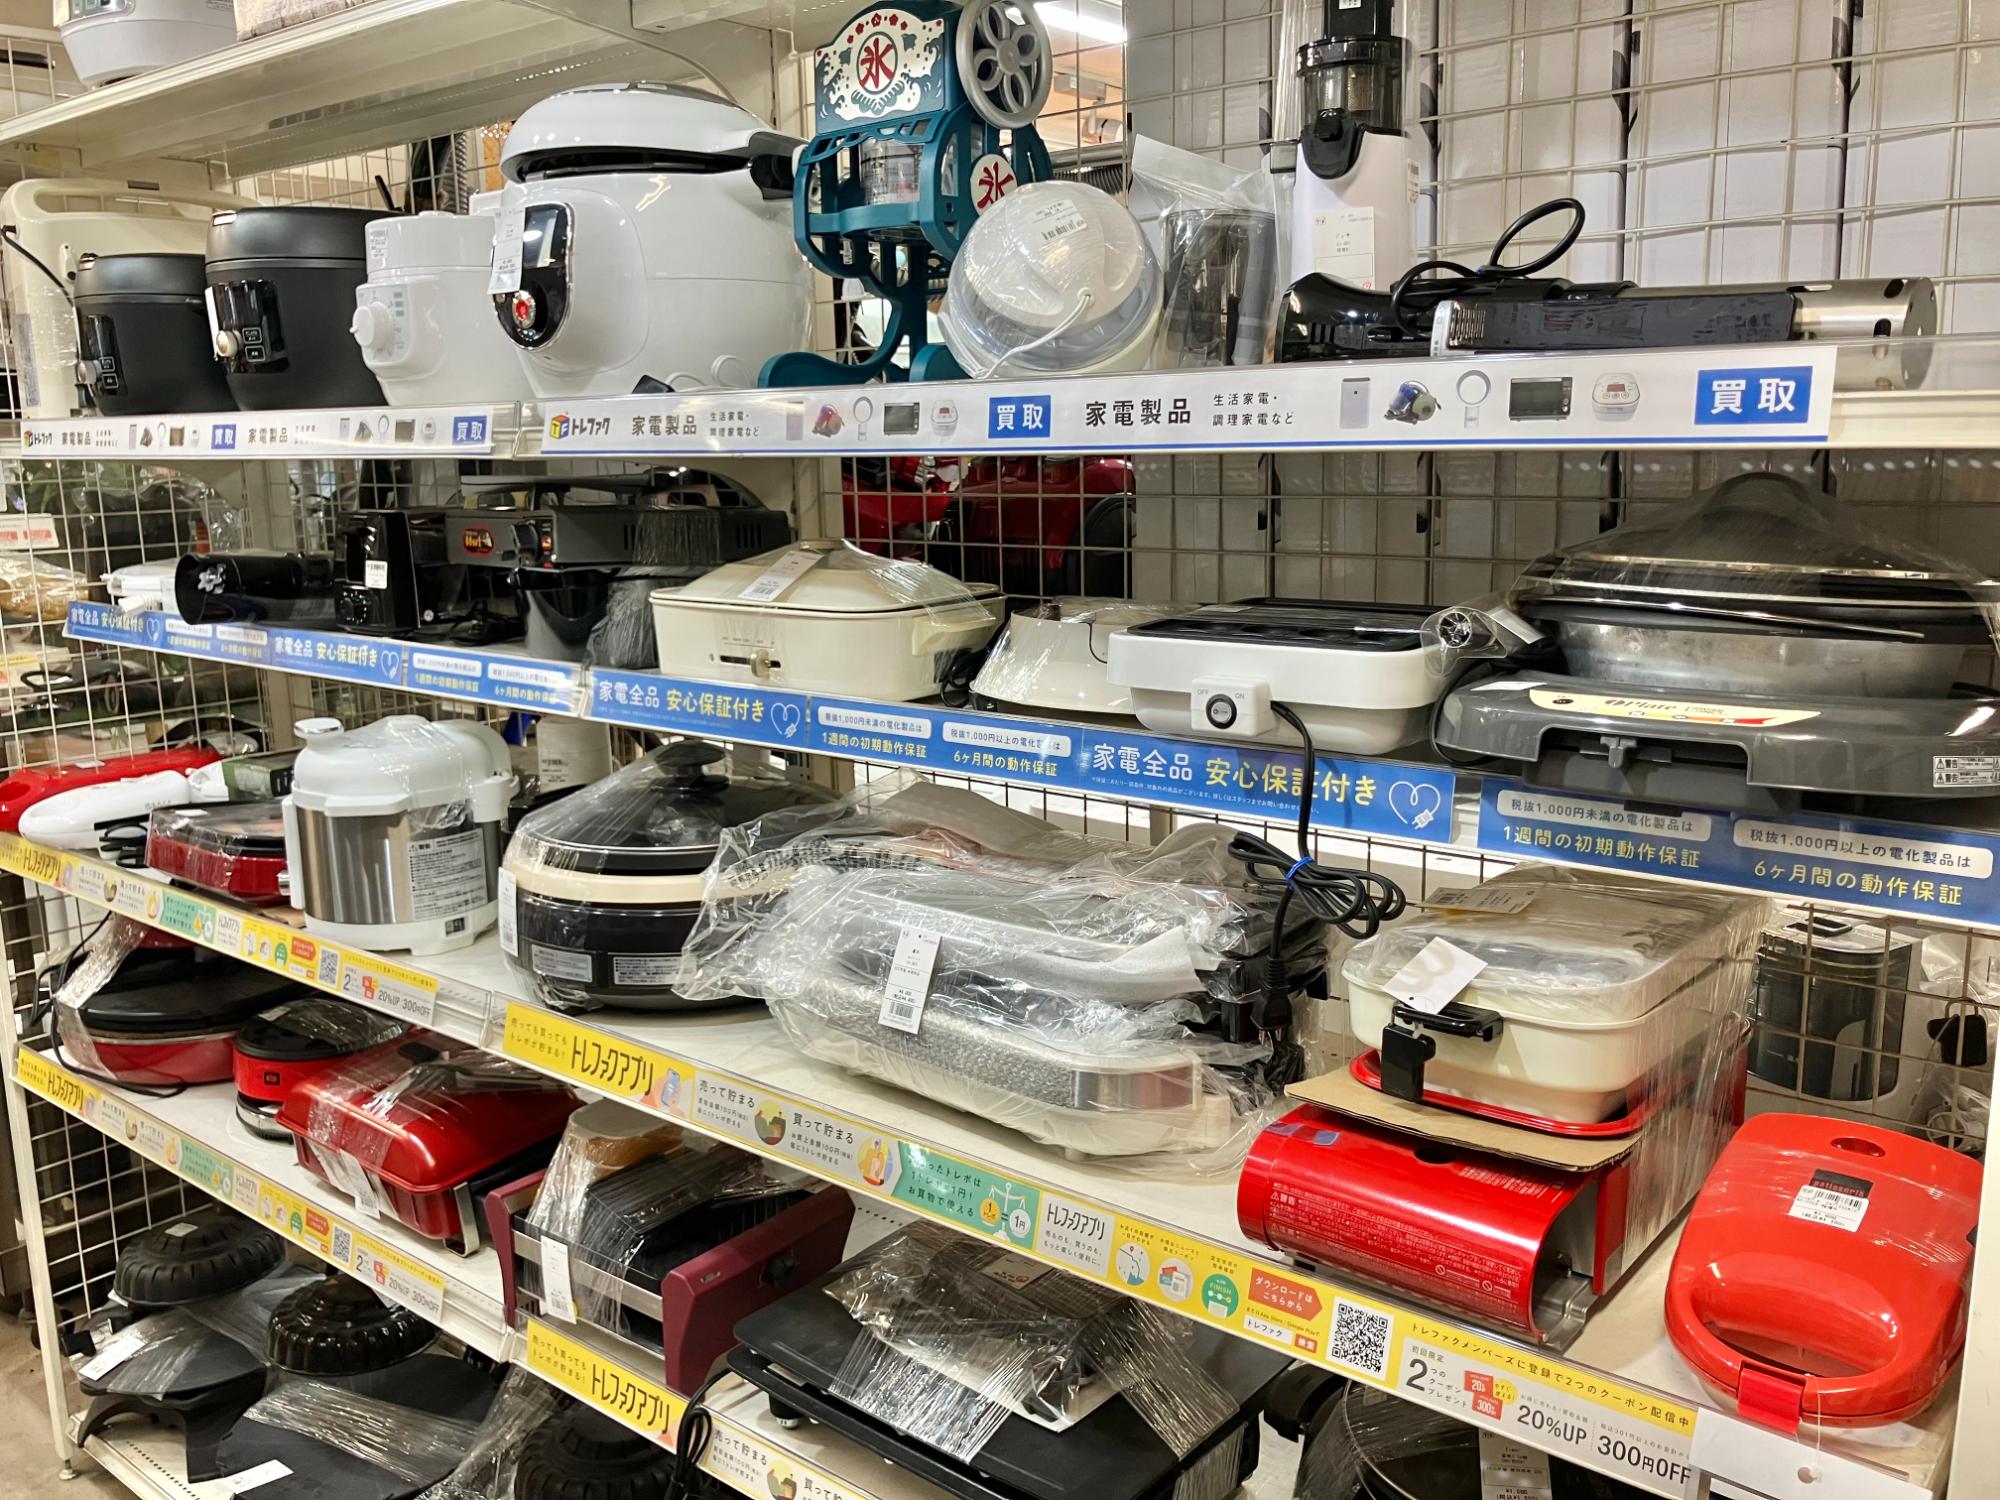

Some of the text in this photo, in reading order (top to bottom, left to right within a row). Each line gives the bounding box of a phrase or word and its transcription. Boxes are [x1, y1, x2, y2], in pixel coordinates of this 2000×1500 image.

[860, 37, 897, 89] 氷
[976, 161, 1015, 209] 氷
[1711, 377, 1798, 415] 買取
[571, 417, 610, 436] トレファク
[631, 415, 697, 436] 家電製品
[996, 404, 1044, 431] 買取
[1085, 398, 1191, 427] 家電製品
[1212, 411, 1294, 427] 調理家電など
[61, 430, 92, 447] 家電製品
[213, 428, 234, 446] 買取
[248, 427, 288, 444] 家電製品
[457, 421, 483, 441] 買取
[273, 636, 313, 658] 家電全品
[315, 641, 378, 668] 安心保証付き
[598, 680, 660, 708] 家電全品
[666, 688, 765, 722] 安心保証付き
[822, 732, 928, 759] 1週間の初期動作保証
[953, 751, 1058, 778] 6ヶ月間の動作保証
[1092, 743, 1193, 781] 家電全品
[1503, 824, 1701, 869] 1週間の初期動作保証
[1753, 859, 1963, 907] 6ヶ月間の動作保証
[571, 1035, 654, 1096] トレファクアプリ
[699, 1079, 755, 1109] 売って貯まる
[792, 1112, 854, 1145] 買って貯まる
[908, 1186, 975, 1218] お買物で使える
[1014, 1215, 1027, 1231] 1円
[1047, 1203, 1106, 1241] トレファクアプリ
[1208, 1282, 1233, 1296] FINISH
[1255, 1276, 1314, 1304] ダウンロードは
[1263, 1291, 1303, 1313] こちらから
[1247, 1318, 1283, 1338] トレファク
[1411, 1345, 1446, 1363] 初回限定
[1406, 1358, 1428, 1392] 2
[1429, 1378, 1461, 1394] クーポン
[591, 1363, 670, 1435] トレファクアプリ
[1427, 1388, 1467, 1408] プレゼント
[1517, 1404, 1588, 1445] 20%UP
[714, 1428, 768, 1467] 売って貯まる
[1597, 1435, 1692, 1485] 300円OFF
